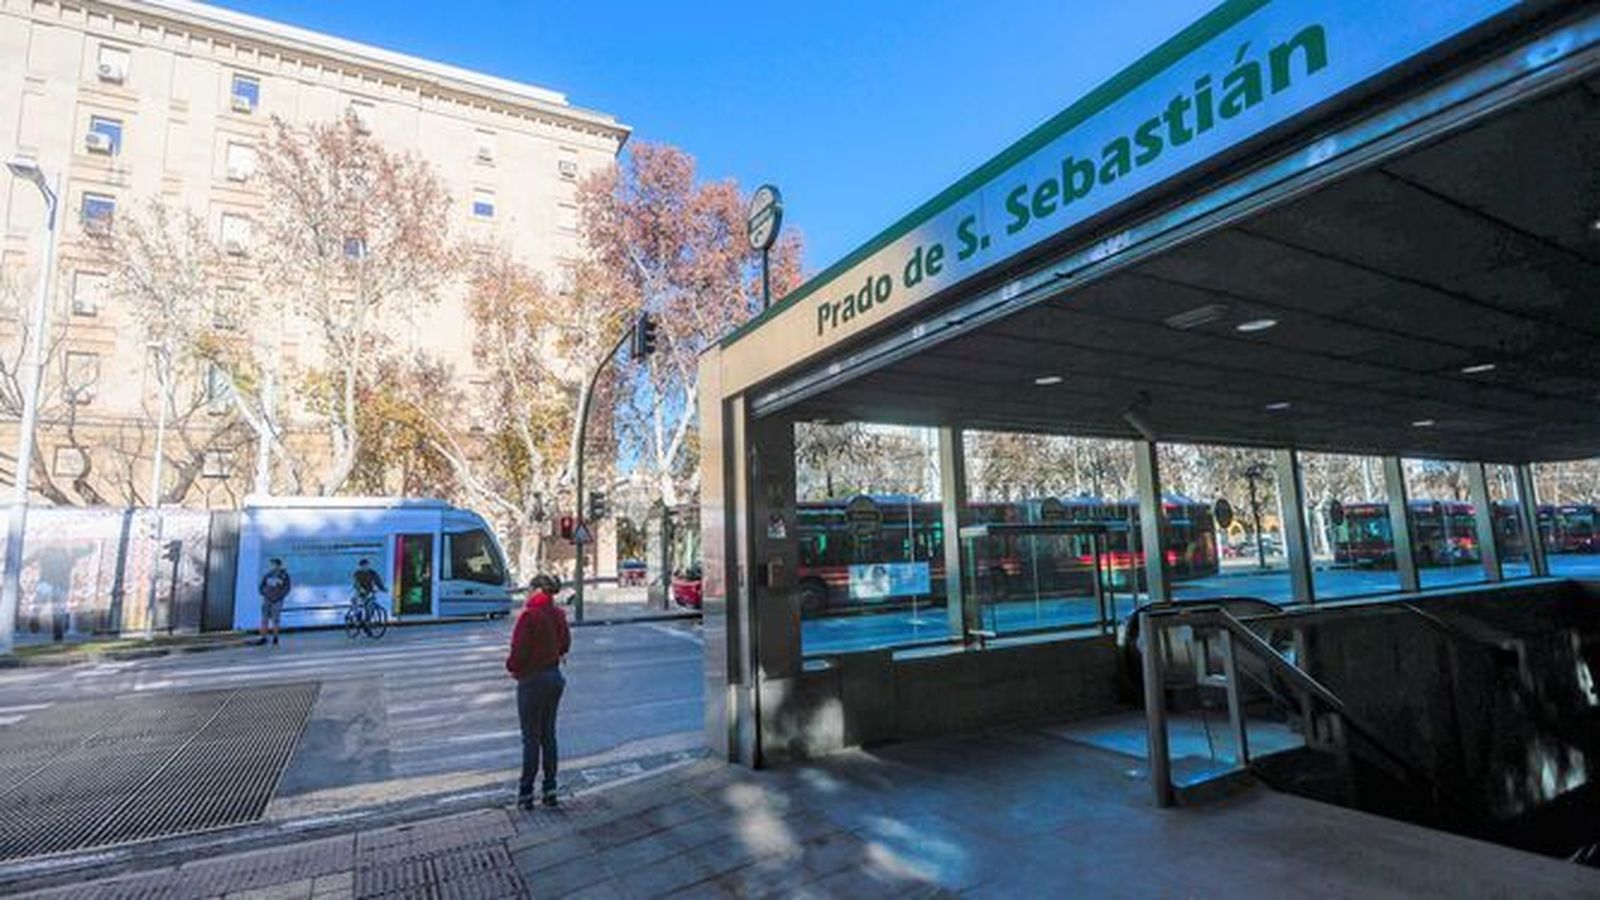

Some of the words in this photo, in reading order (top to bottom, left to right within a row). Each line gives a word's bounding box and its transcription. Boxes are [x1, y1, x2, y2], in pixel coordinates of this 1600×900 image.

[817, 274, 892, 336] Prado
[903, 242, 944, 289] de
[957, 213, 991, 261] S.
[1005, 23, 1327, 235] Sebastián
